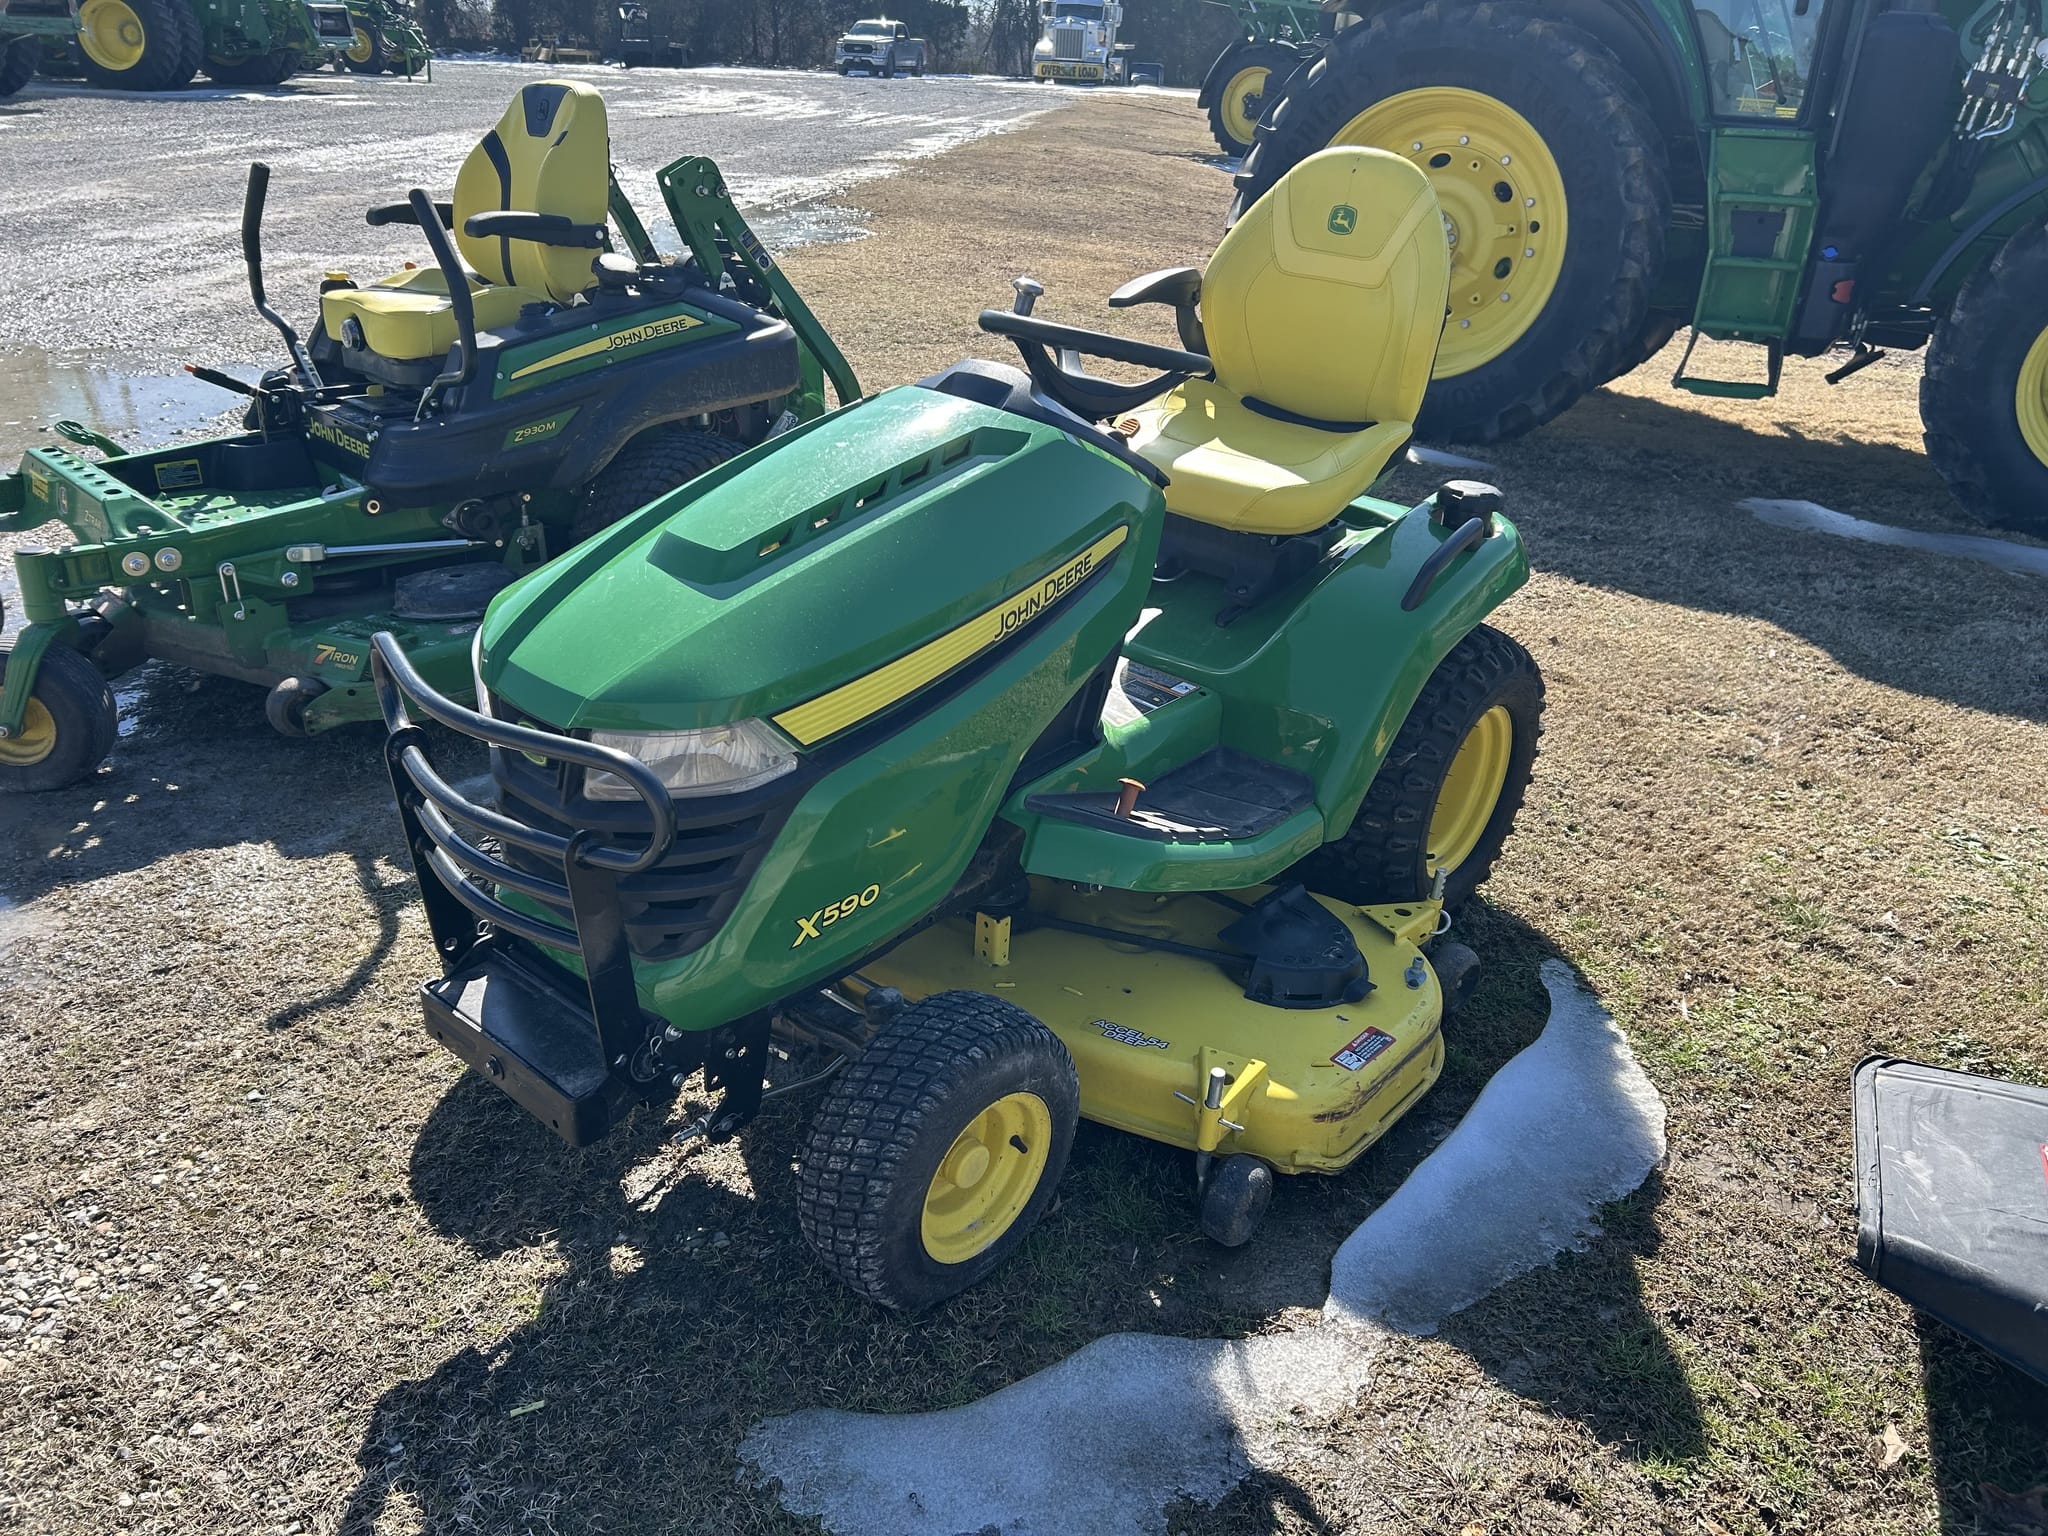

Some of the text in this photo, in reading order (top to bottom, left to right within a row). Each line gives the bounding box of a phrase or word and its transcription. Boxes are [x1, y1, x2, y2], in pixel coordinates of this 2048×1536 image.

[1041, 64, 1098, 78] OVERSE LOAD
[606, 319, 688, 350] JOHN DEERE
[309, 416, 370, 459] JOHN DEERE
[513, 421, 556, 442] Z930M
[994, 553, 1093, 640] JOHN DEERE
[789, 883, 880, 951] X590
[1090, 1019, 1169, 1049] ACCEL 54
[1101, 1029, 1148, 1047] DEEP
